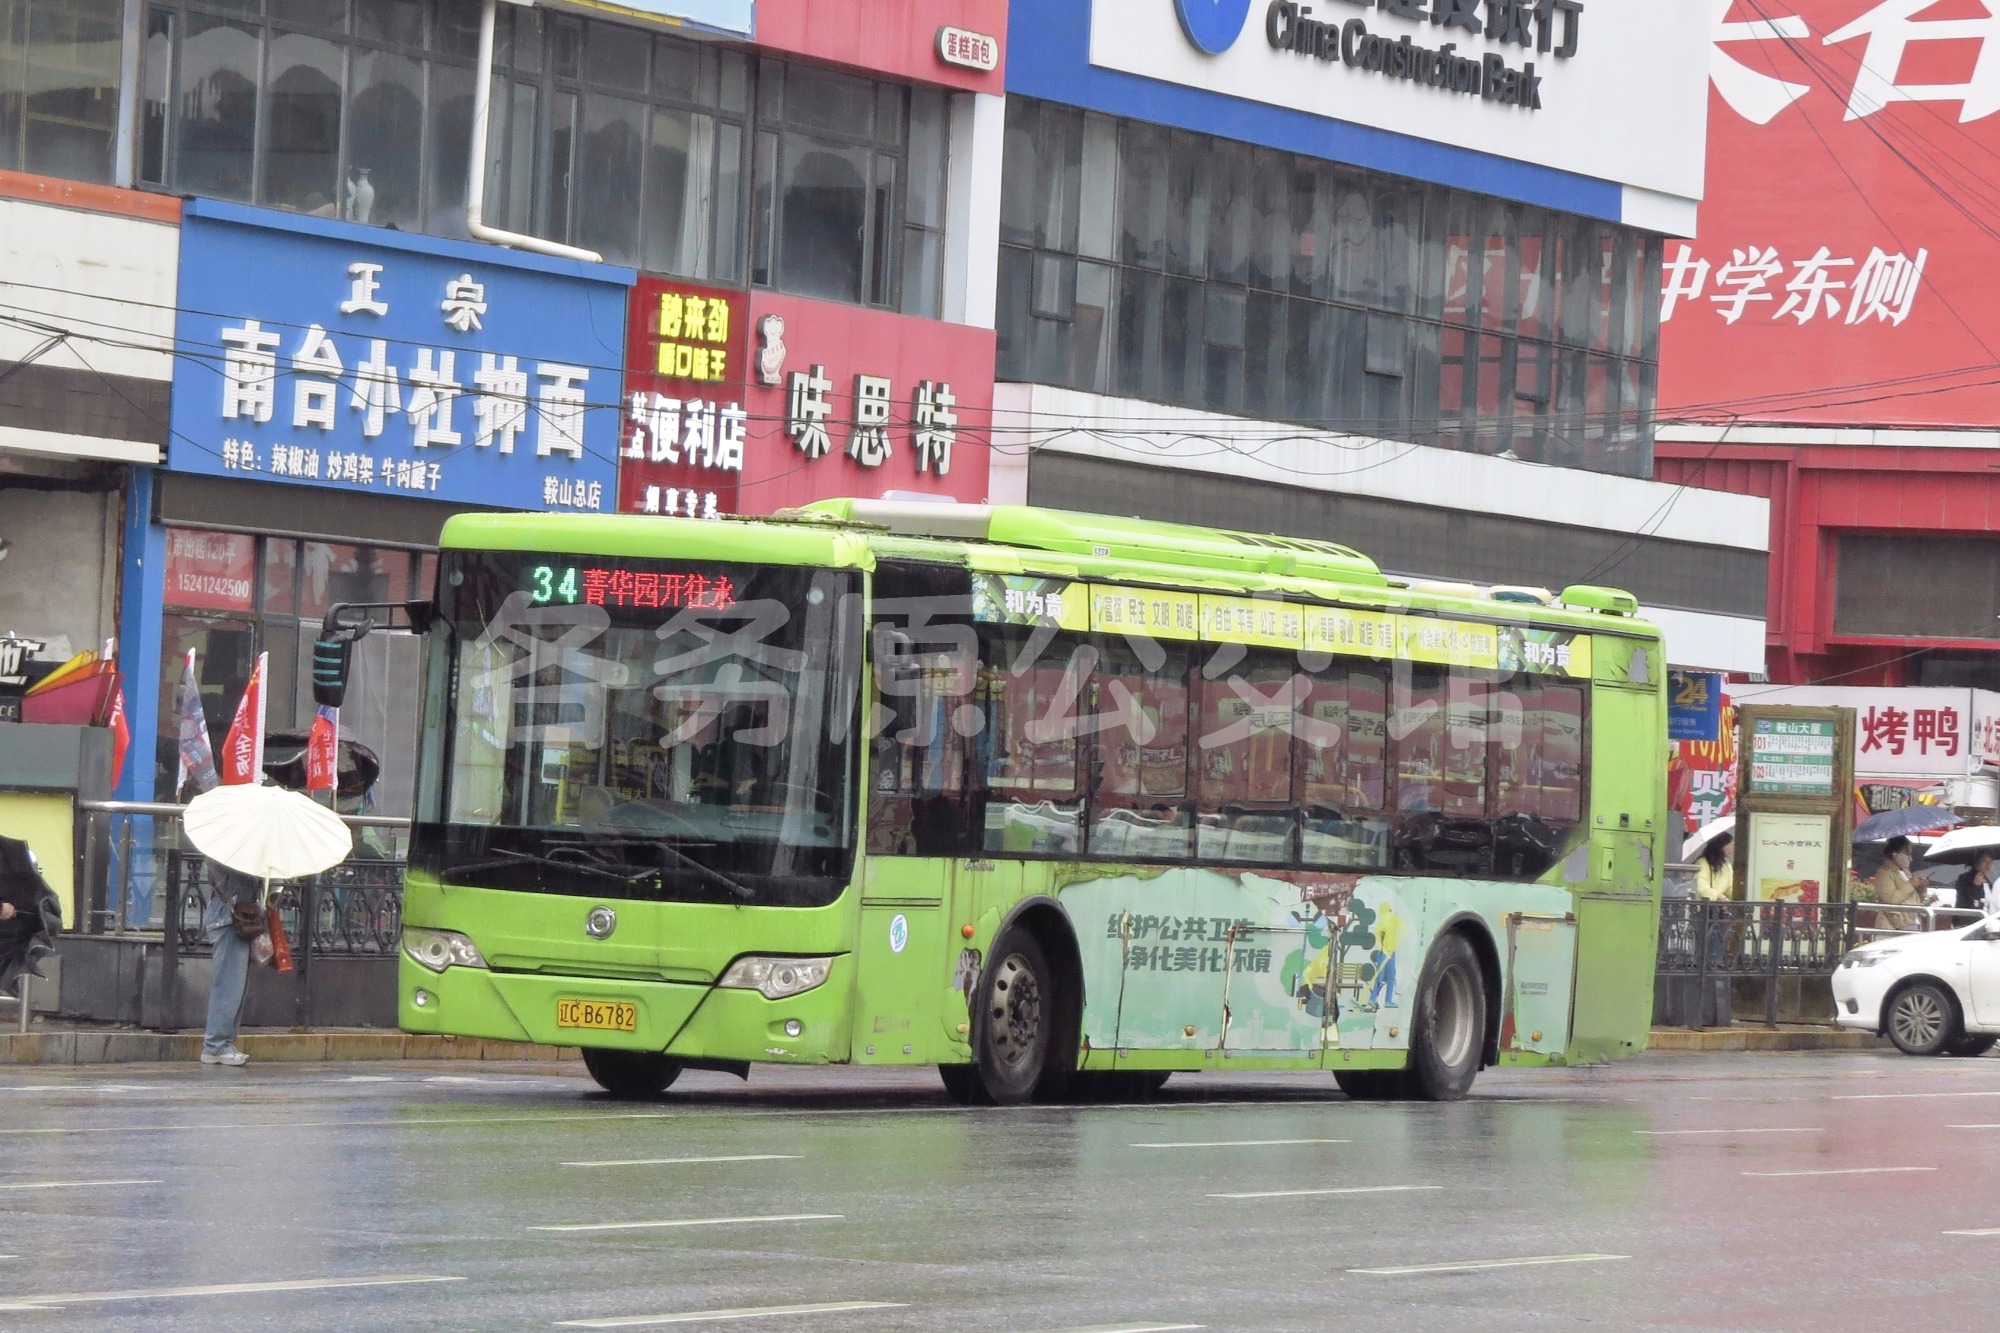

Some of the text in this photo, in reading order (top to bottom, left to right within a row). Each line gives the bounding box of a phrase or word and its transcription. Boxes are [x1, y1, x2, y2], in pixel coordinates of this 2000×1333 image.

[947, 32, 990, 64] 蛋糕面包
[1266, 0, 1543, 109] China Construction Bank
[340, 262, 488, 331] 正宗
[221, 319, 590, 459] 南台小杜抻面
[650, 392, 748, 471] 便利店
[788, 364, 958, 475] 味思特
[270, 443, 319, 479] 辣椒油
[327, 450, 374, 484] 炒鸡架
[543, 475, 601, 509] 鞍山总店
[178, 574, 250, 598] 15241242500
[532, 566, 736, 611] 34 菁华园开往永
[1005, 588, 1062, 617] 和为贵
[1103, 595, 1194, 630] 富强 民主 文明 和谐
[1215, 606, 1298, 640] 自由 平等 公正 法治
[1320, 616, 1335, 644] 爱国
[1359, 620, 1373, 647] 诚信
[1523, 641, 1570, 667] 和为贵
[1860, 705, 1960, 757] 烤鸭
[1106, 913, 1256, 943] 维护公共卫生
[1126, 947, 1272, 973] 净化美化环境
